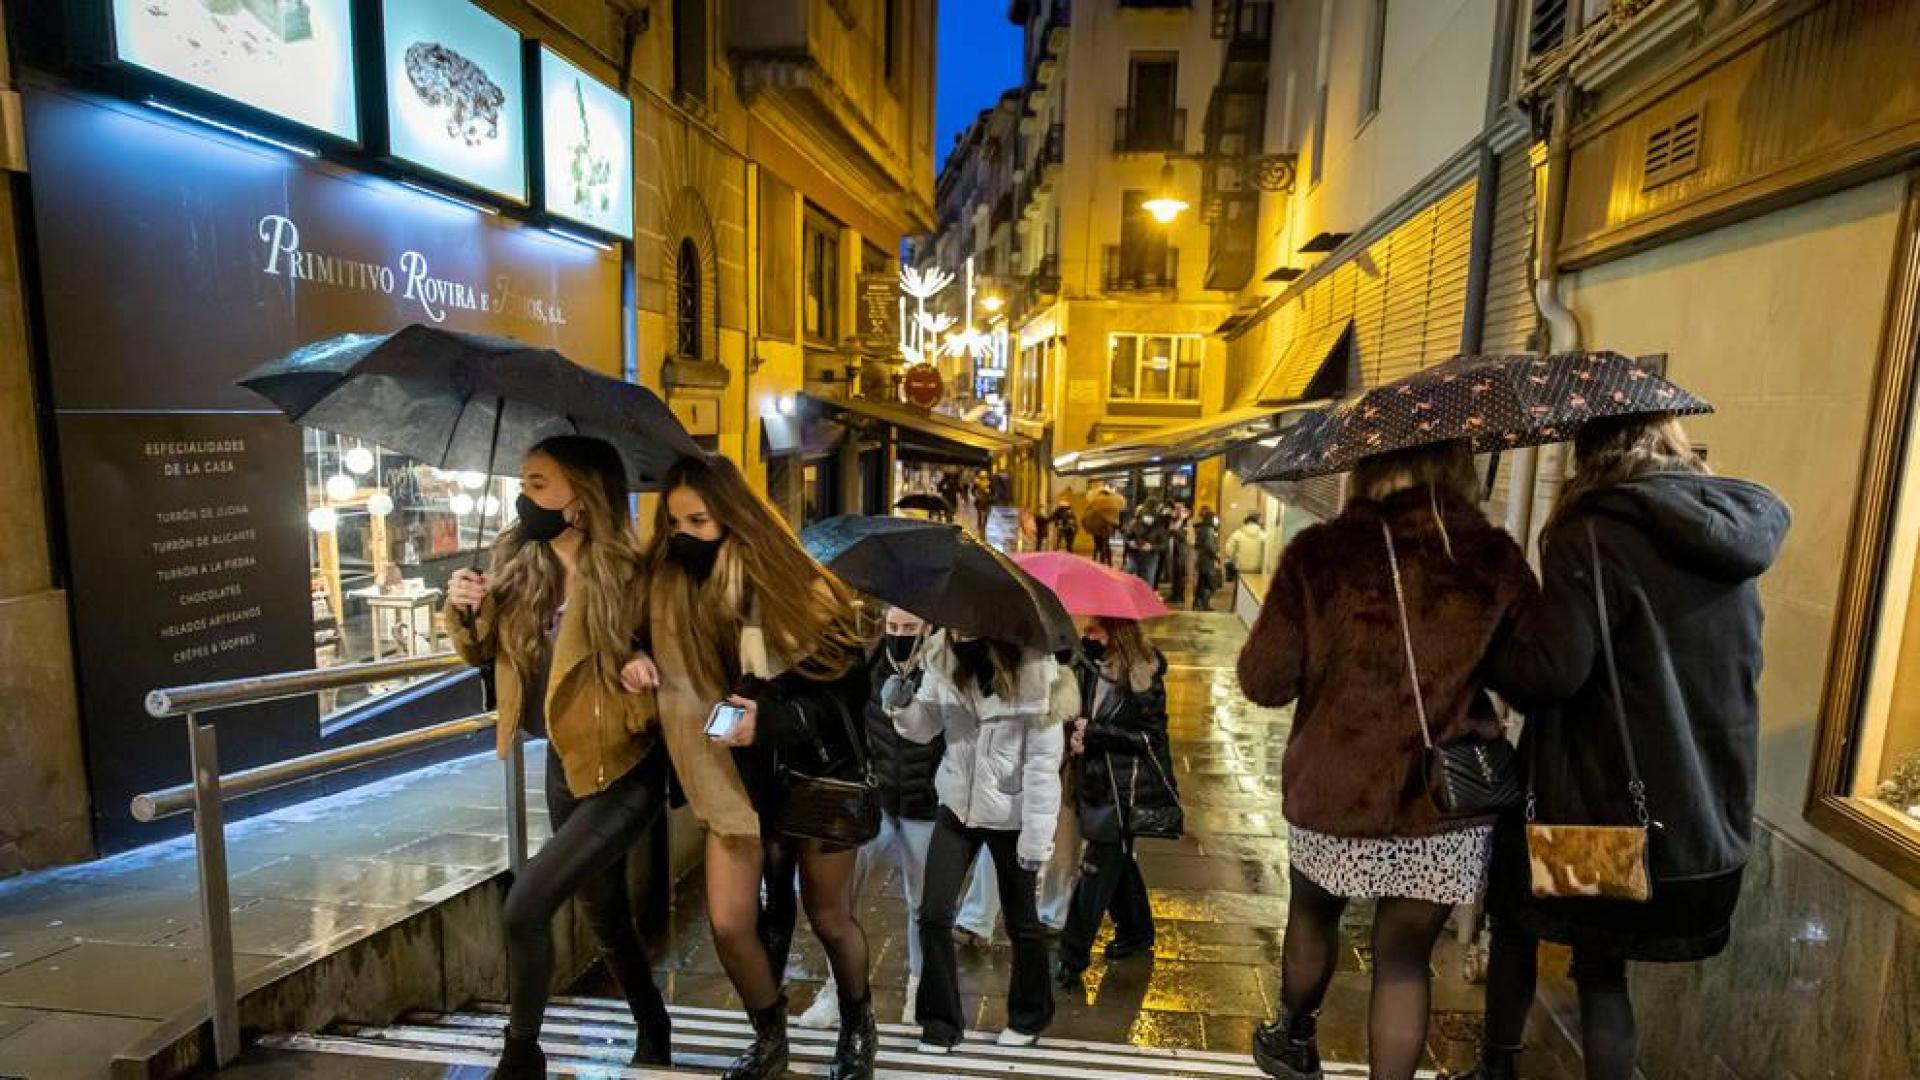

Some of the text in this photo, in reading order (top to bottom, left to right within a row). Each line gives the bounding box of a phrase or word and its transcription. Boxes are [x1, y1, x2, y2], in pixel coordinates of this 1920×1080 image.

[259, 214, 395, 294] PRIMITIVO
[400, 250, 477, 323] ROVIRA
[480, 292, 490, 311] E
[144, 440, 245, 456] ESPECIALIDADES
[164, 460, 234, 476] DE LA CASA
[200, 507, 215, 519] DE
[152, 528, 256, 554] TURRÓN DE ALICANTE
[156, 565, 198, 582] TURRÓN
[201, 563, 208, 574] A
[210, 560, 222, 572] LA
[179, 583, 242, 606] CHOCOLATES
[160, 606, 262, 637] HELADOS ARTESANOS
